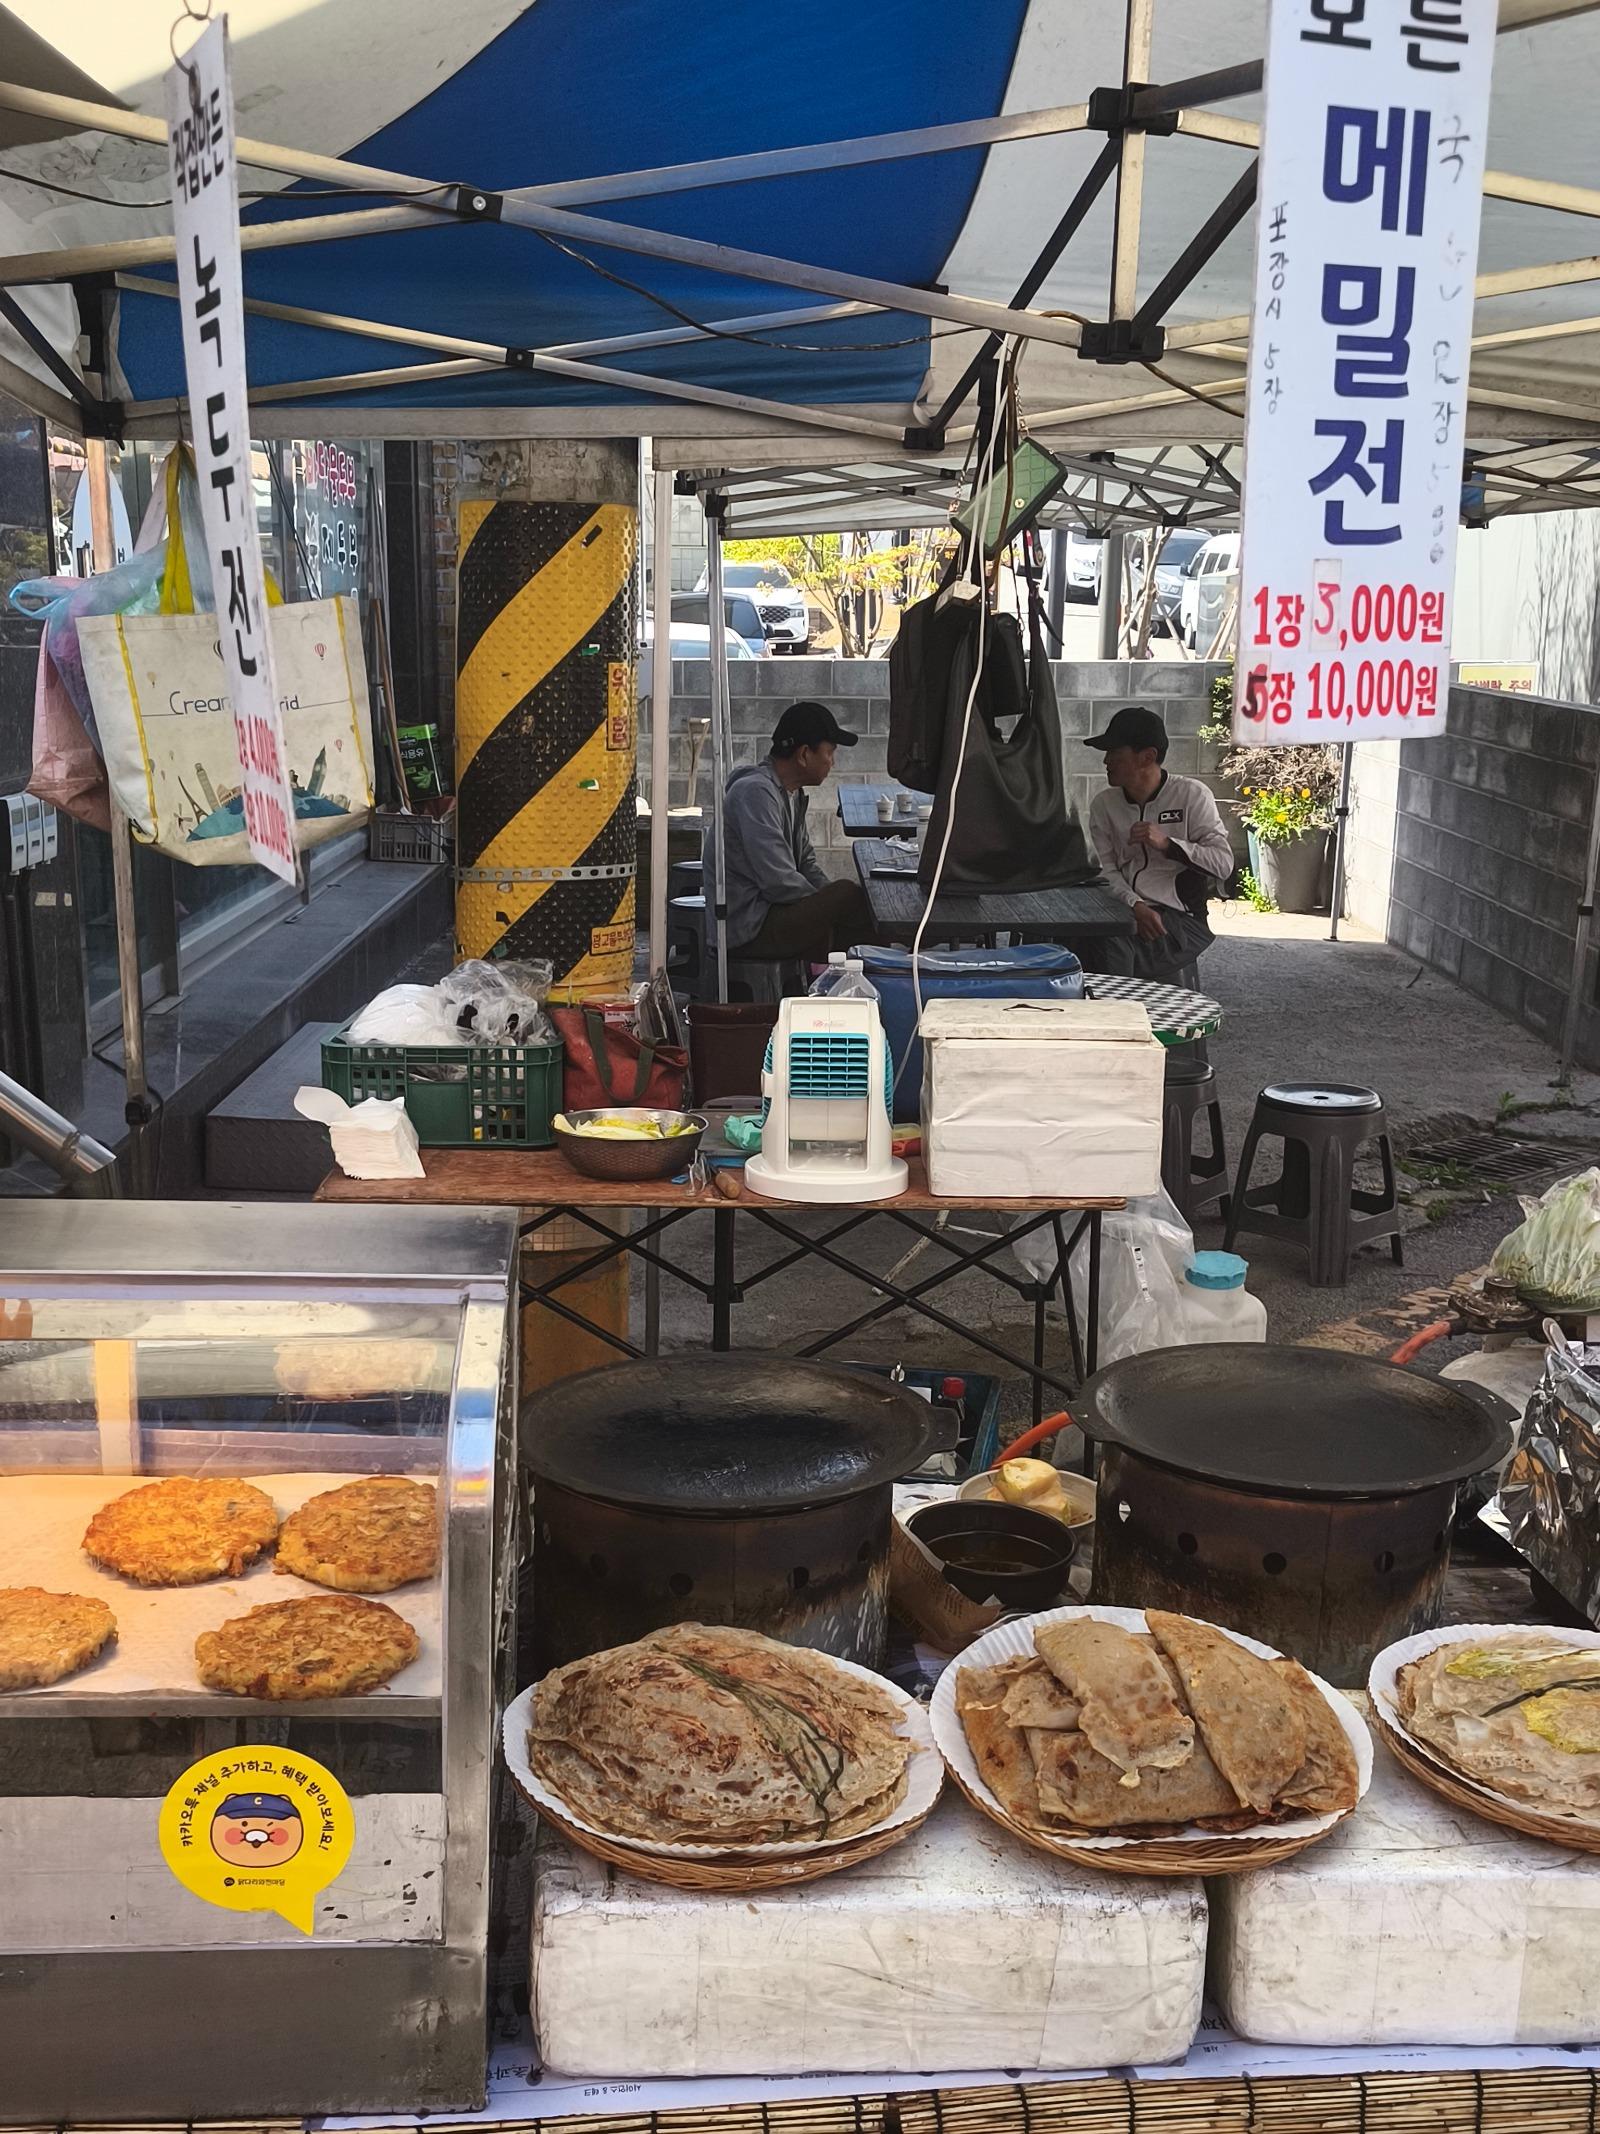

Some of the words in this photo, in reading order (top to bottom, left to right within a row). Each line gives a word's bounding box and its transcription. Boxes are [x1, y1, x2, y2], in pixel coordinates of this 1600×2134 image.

[1307, 104, 1432, 546] 메밀전
[193, 233, 258, 678] 녹두전
[1253, 585, 1305, 649] 1장
[1307, 658, 1438, 726] 10,000원
[178, 1797, 200, 1848] 카카오톡
[193, 1774, 221, 1796] 채널
[220, 1760, 278, 1780] 추가하고,
[281, 1765, 308, 1787] 혜택
[305, 1781, 336, 1851] 받아보세요!
